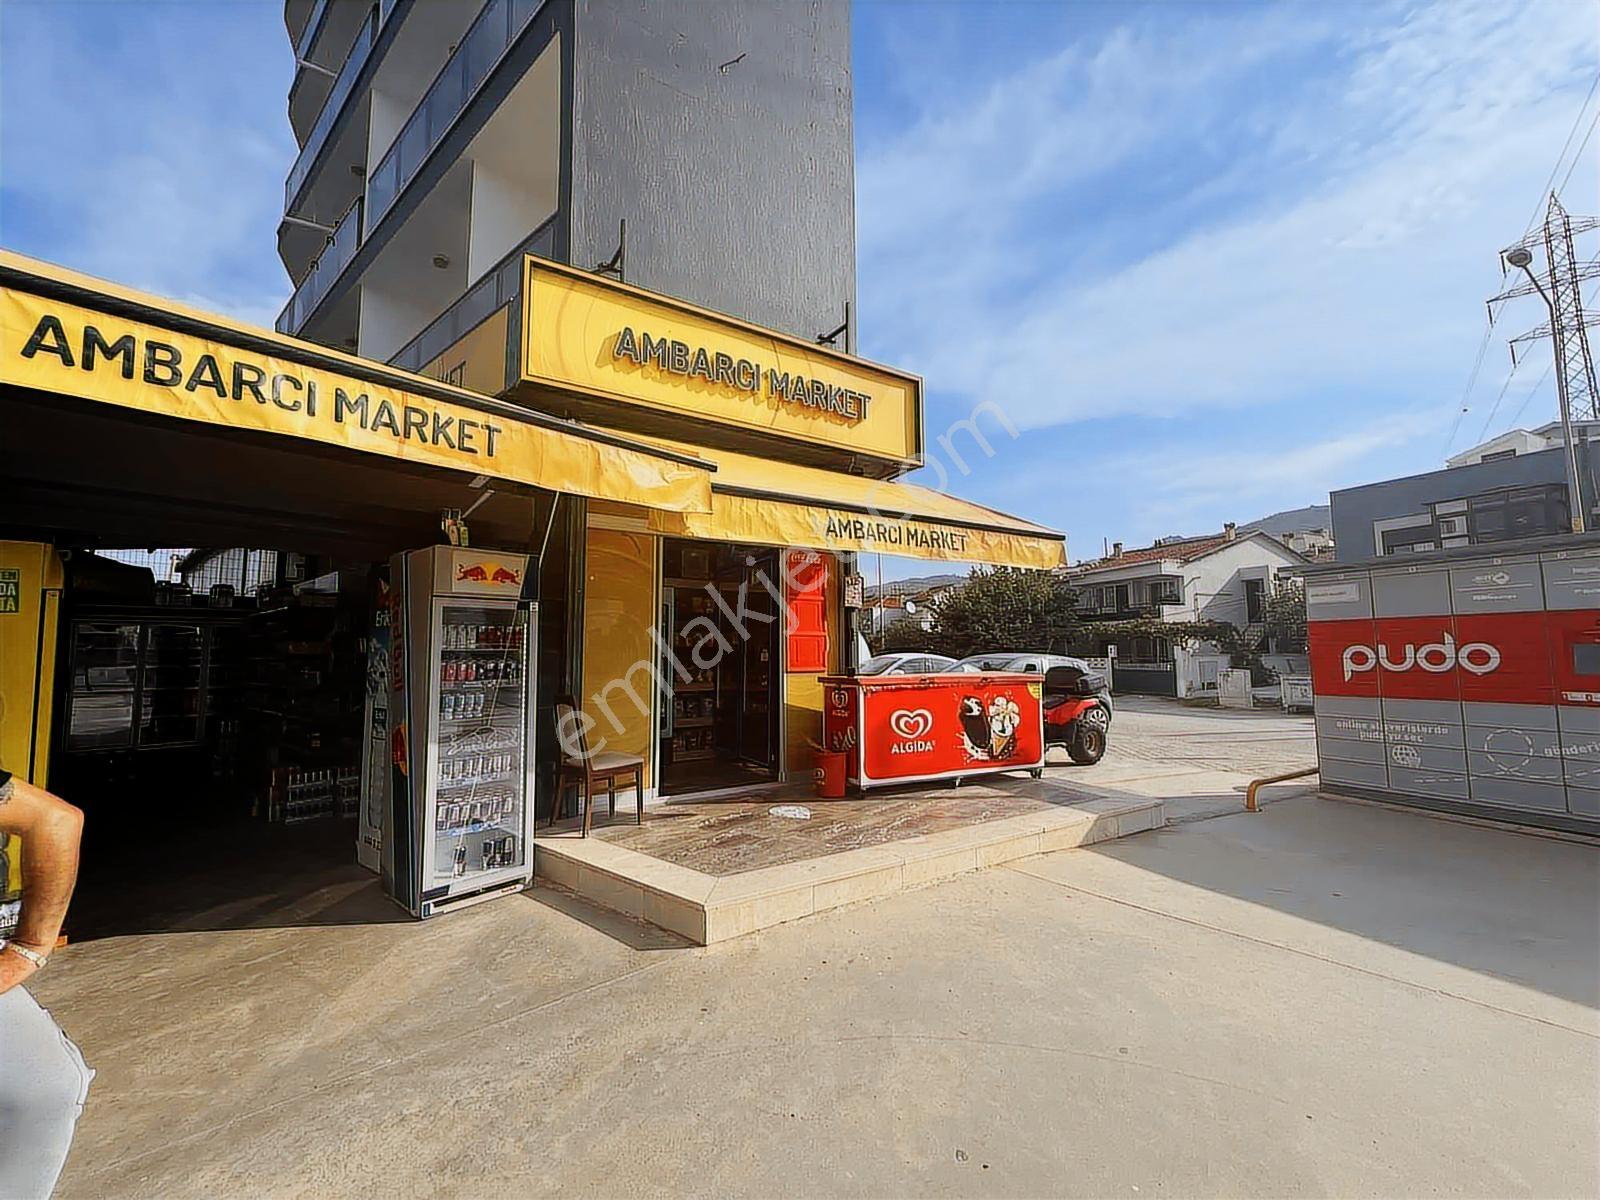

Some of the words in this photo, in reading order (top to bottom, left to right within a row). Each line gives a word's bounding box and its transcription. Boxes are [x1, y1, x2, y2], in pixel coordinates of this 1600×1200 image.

[21, 314, 317, 417] AMBARCI
[334, 386, 503, 458] MARKET
[615, 326, 762, 392] AMBARCI
[770, 367, 872, 420] MARKET
[825, 514, 903, 545] AMBARCI
[907, 528, 967, 554] MARKET
[1342, 630, 1501, 683] pudo
